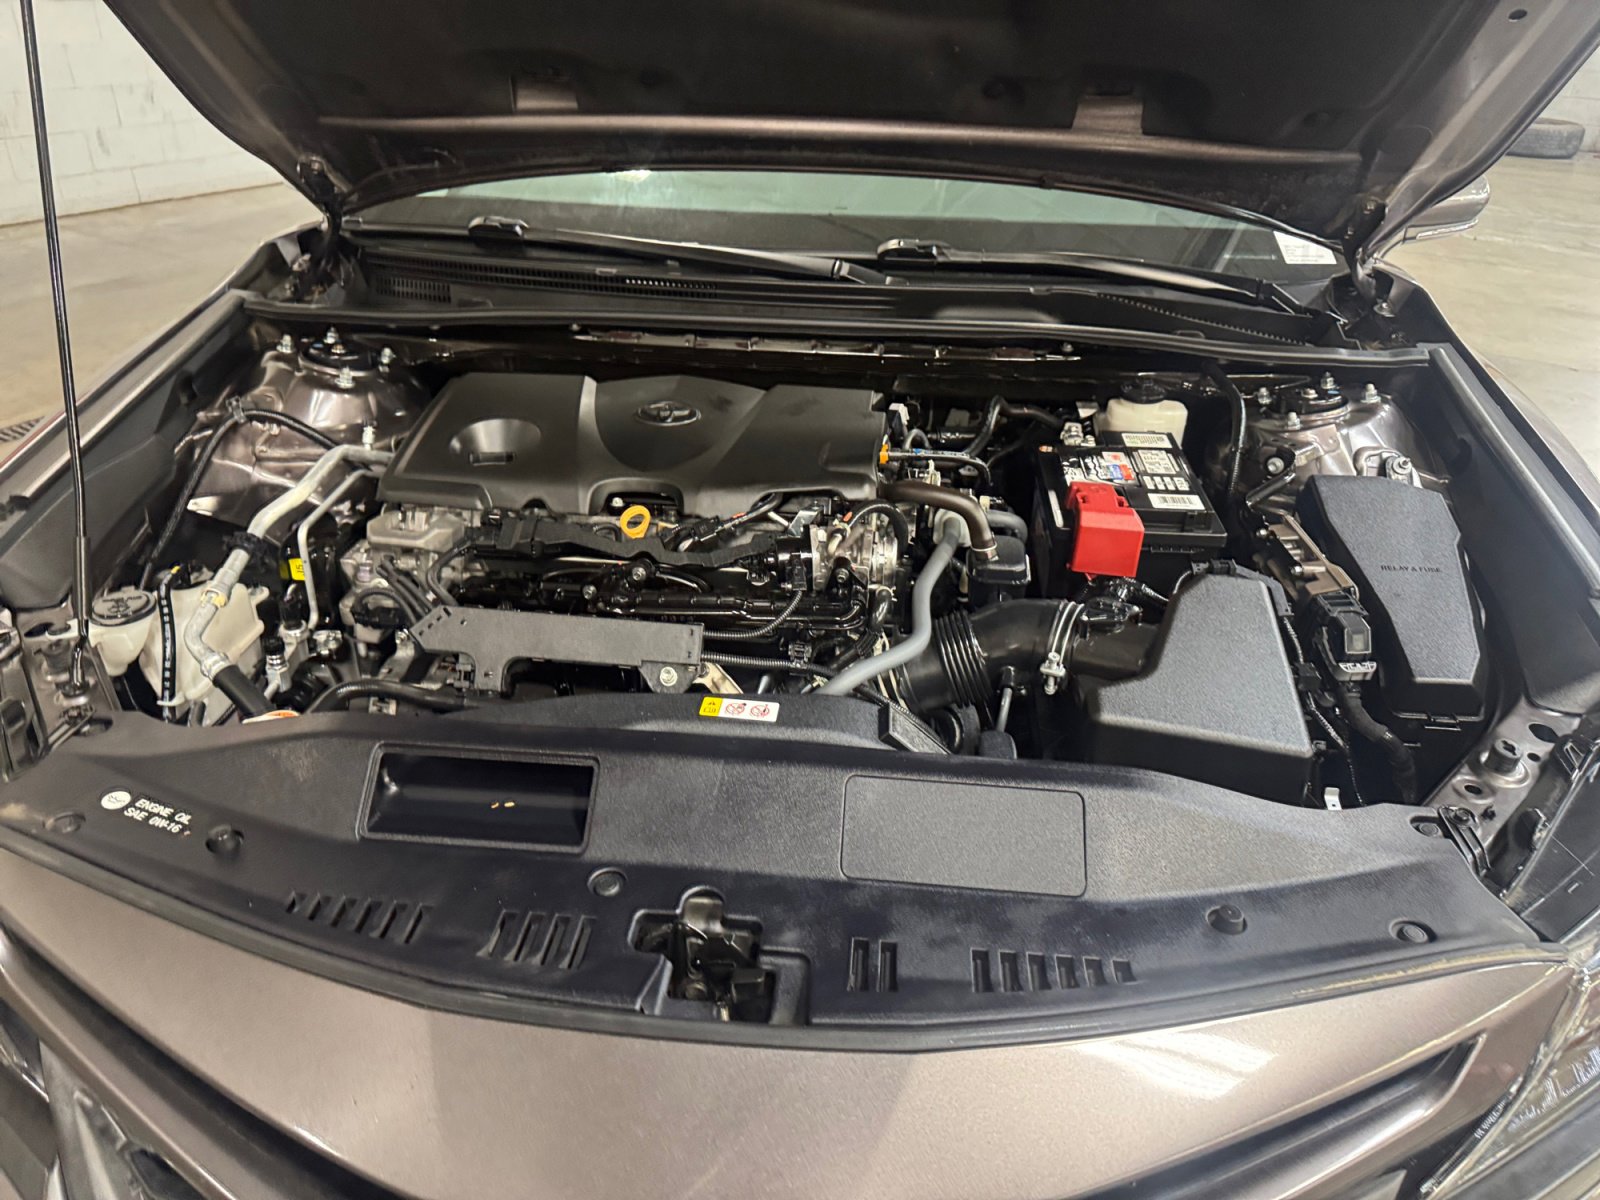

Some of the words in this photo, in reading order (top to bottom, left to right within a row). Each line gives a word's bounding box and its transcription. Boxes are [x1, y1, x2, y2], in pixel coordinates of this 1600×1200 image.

[123, 807, 149, 821] SAE
[148, 816, 182, 833] 0W-16
[135, 798, 174, 817] ENGINE
[174, 812, 192, 825] OIL
